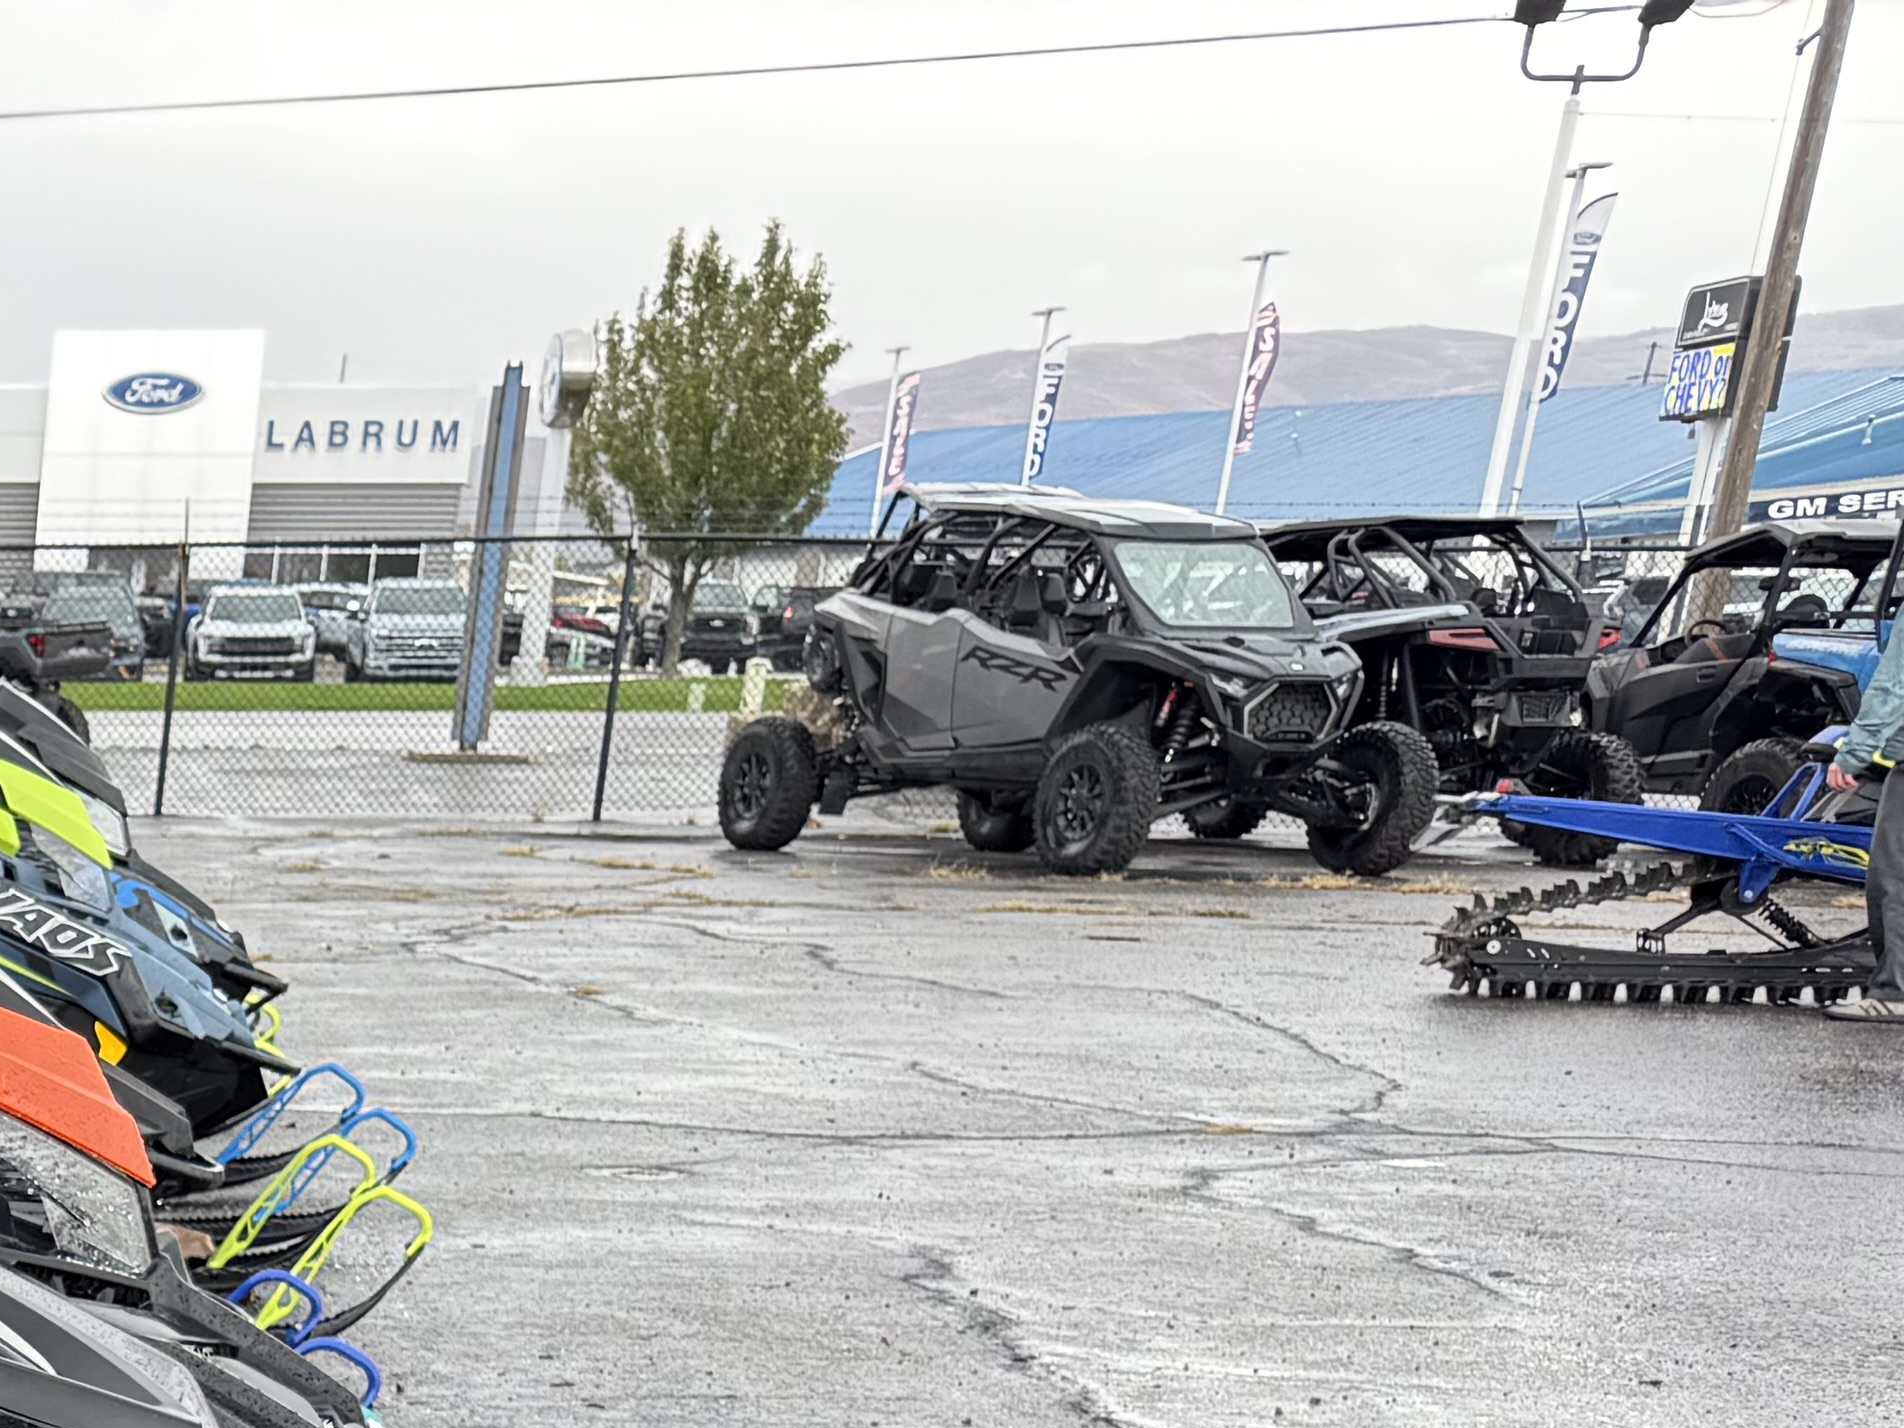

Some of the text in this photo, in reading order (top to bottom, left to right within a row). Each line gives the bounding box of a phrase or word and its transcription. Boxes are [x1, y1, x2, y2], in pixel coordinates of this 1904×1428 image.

[1540, 252, 1592, 400] FORD
[1668, 350, 1712, 384] FORD
[264, 419, 461, 453] LABRUM
[1028, 376, 1060, 477] FORD
[1767, 497, 1827, 519] GM
[960, 644, 1068, 693] RZR
